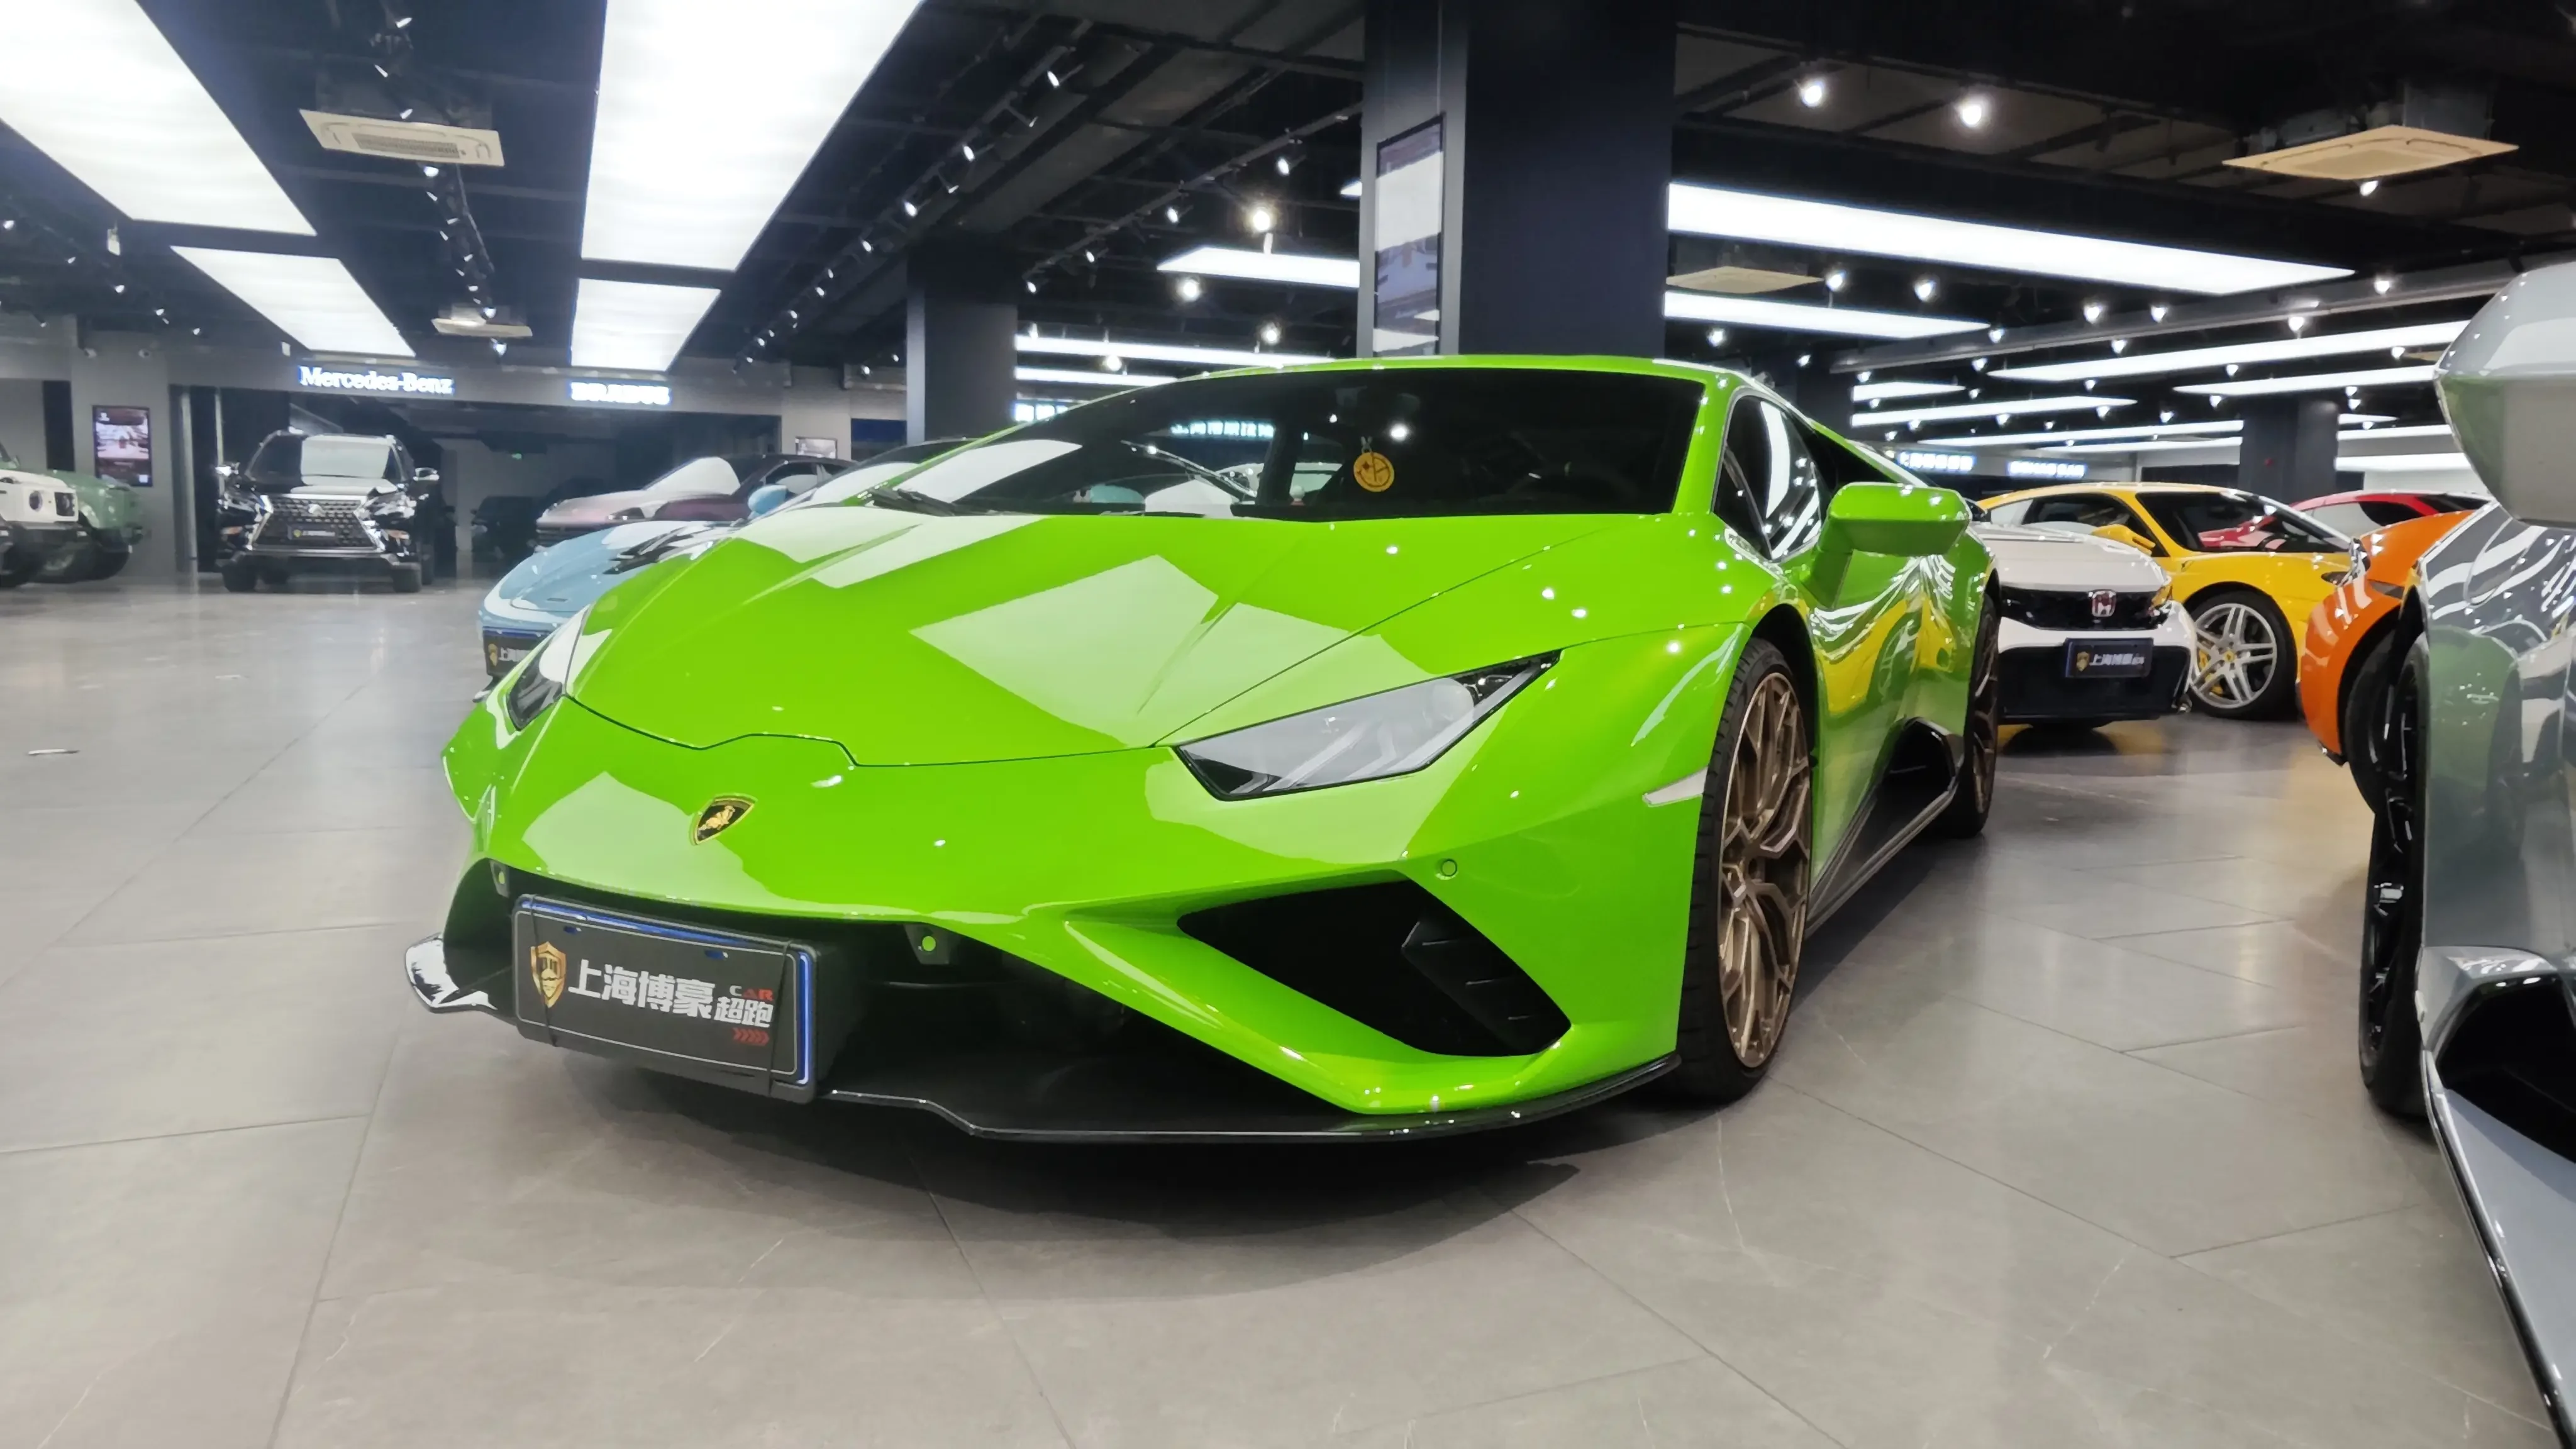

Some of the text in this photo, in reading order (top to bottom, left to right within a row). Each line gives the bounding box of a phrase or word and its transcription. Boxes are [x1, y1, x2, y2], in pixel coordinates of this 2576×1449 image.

[299, 365, 453, 394] Mercedes-Benz
[568, 958, 716, 1019] 上海博豪
[714, 996, 774, 1028] 超跑
[729, 985, 774, 1001] CAR
